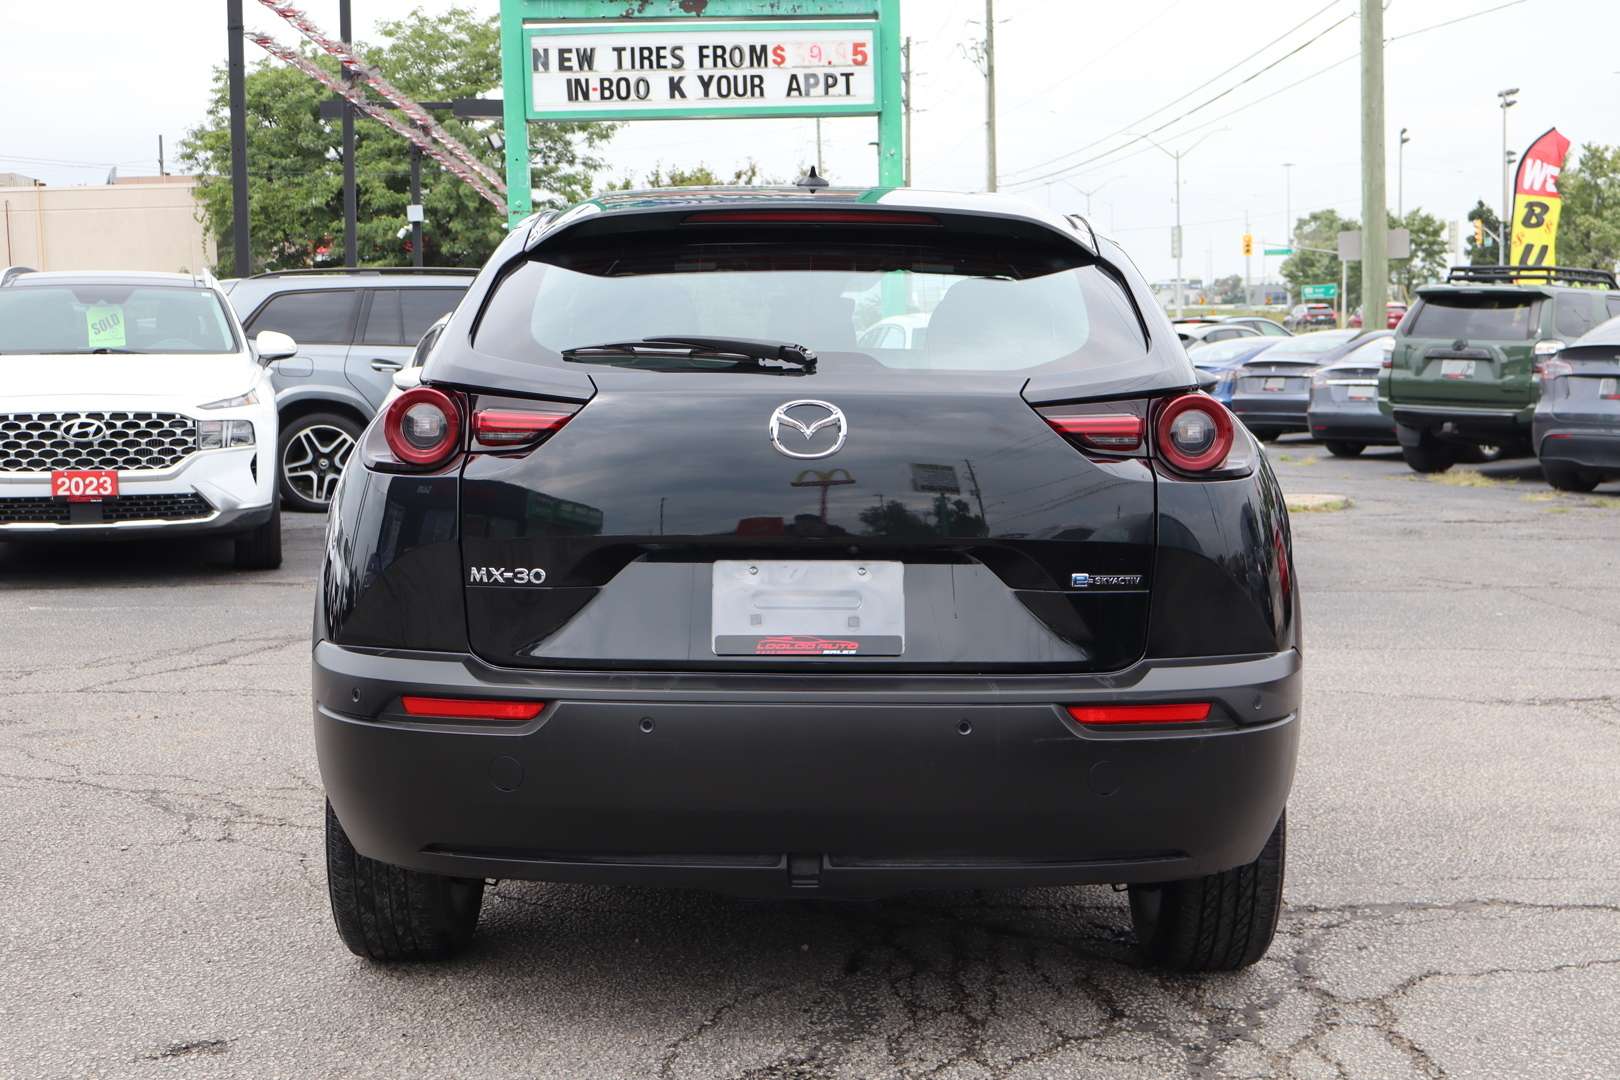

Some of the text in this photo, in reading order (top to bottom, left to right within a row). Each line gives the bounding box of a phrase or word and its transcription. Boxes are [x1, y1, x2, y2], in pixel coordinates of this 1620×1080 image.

[532, 47, 596, 72] NEW
[612, 45, 685, 70] TIRES
[697, 74, 765, 98] YOUR
[786, 72, 855, 97] APPT
[1522, 158, 1560, 193] WE
[91, 312, 121, 336] SOLD
[56, 476, 113, 496] 2023
[470, 566, 546, 584] MX-30
